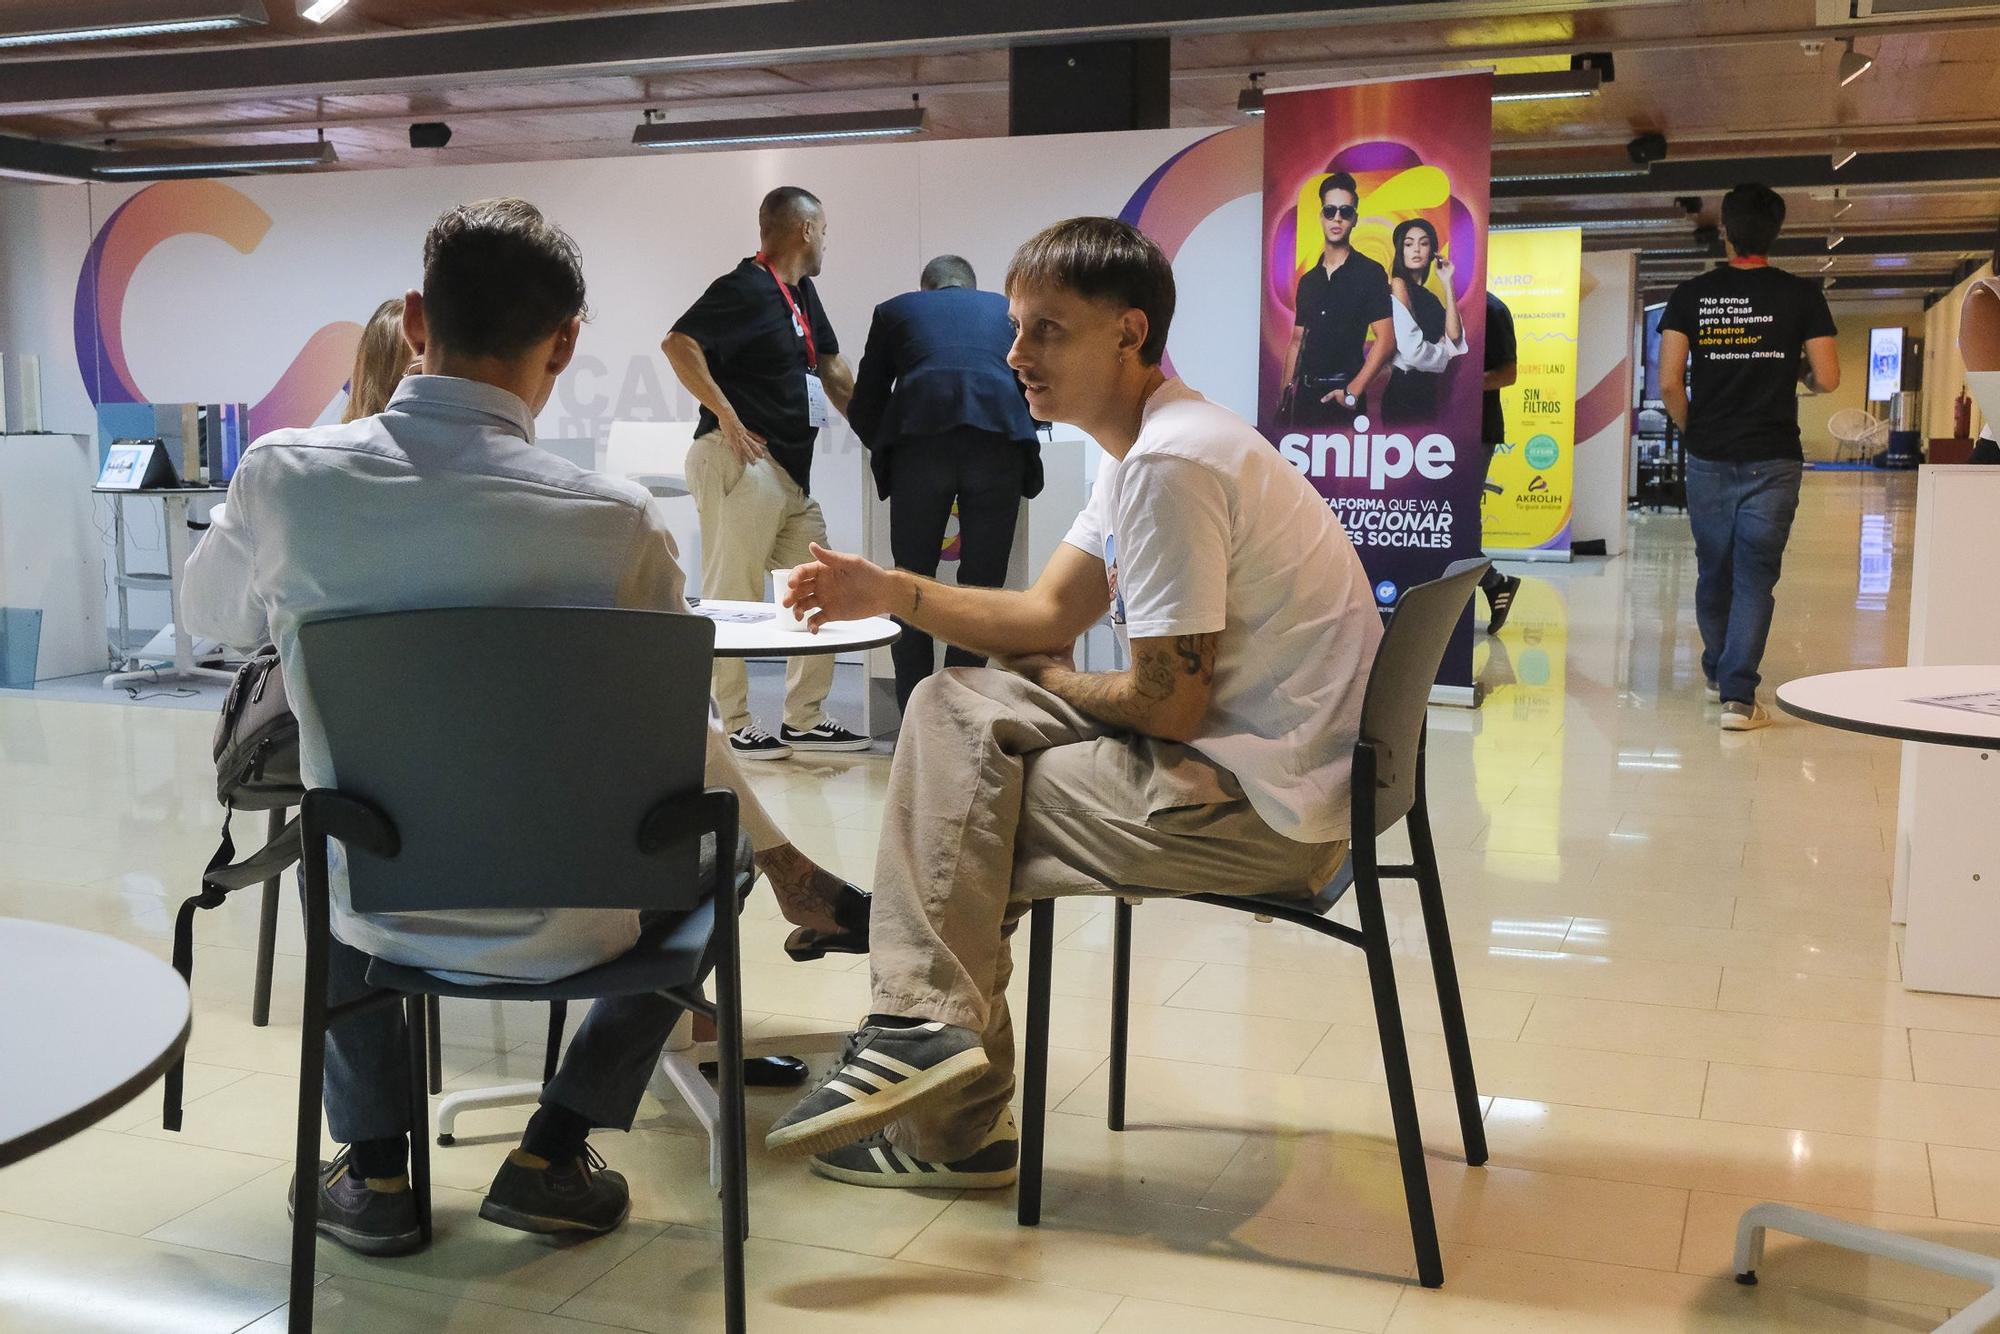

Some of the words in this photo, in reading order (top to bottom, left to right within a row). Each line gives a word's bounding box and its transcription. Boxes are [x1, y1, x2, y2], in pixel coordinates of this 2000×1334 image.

[1719, 297, 1749, 305] somos
[1699, 306, 1725, 315] Mario
[1726, 306, 1753, 314] Casas
[1699, 317, 1720, 326] pero
[1733, 315, 1774, 324] llevamos
[1713, 327, 1745, 335] metros
[1699, 337, 1722, 345] sobre
[1724, 337, 1733, 345] el
[1710, 352, 1750, 360] Beedrone
[1524, 388, 1541, 401] SIN
[1523, 401, 1562, 413] FILTROS
[1279, 414, 1456, 490] snipe
[1515, 494, 1562, 503] AKROLIH
[1388, 498, 1417, 511] QUE
[1420, 499, 1439, 512] VA
[1441, 500, 1453, 512] A
[1337, 510, 1454, 532] LUCIONAR
[1344, 530, 1364, 546] ES
[1367, 531, 1452, 549] SOCIALES
